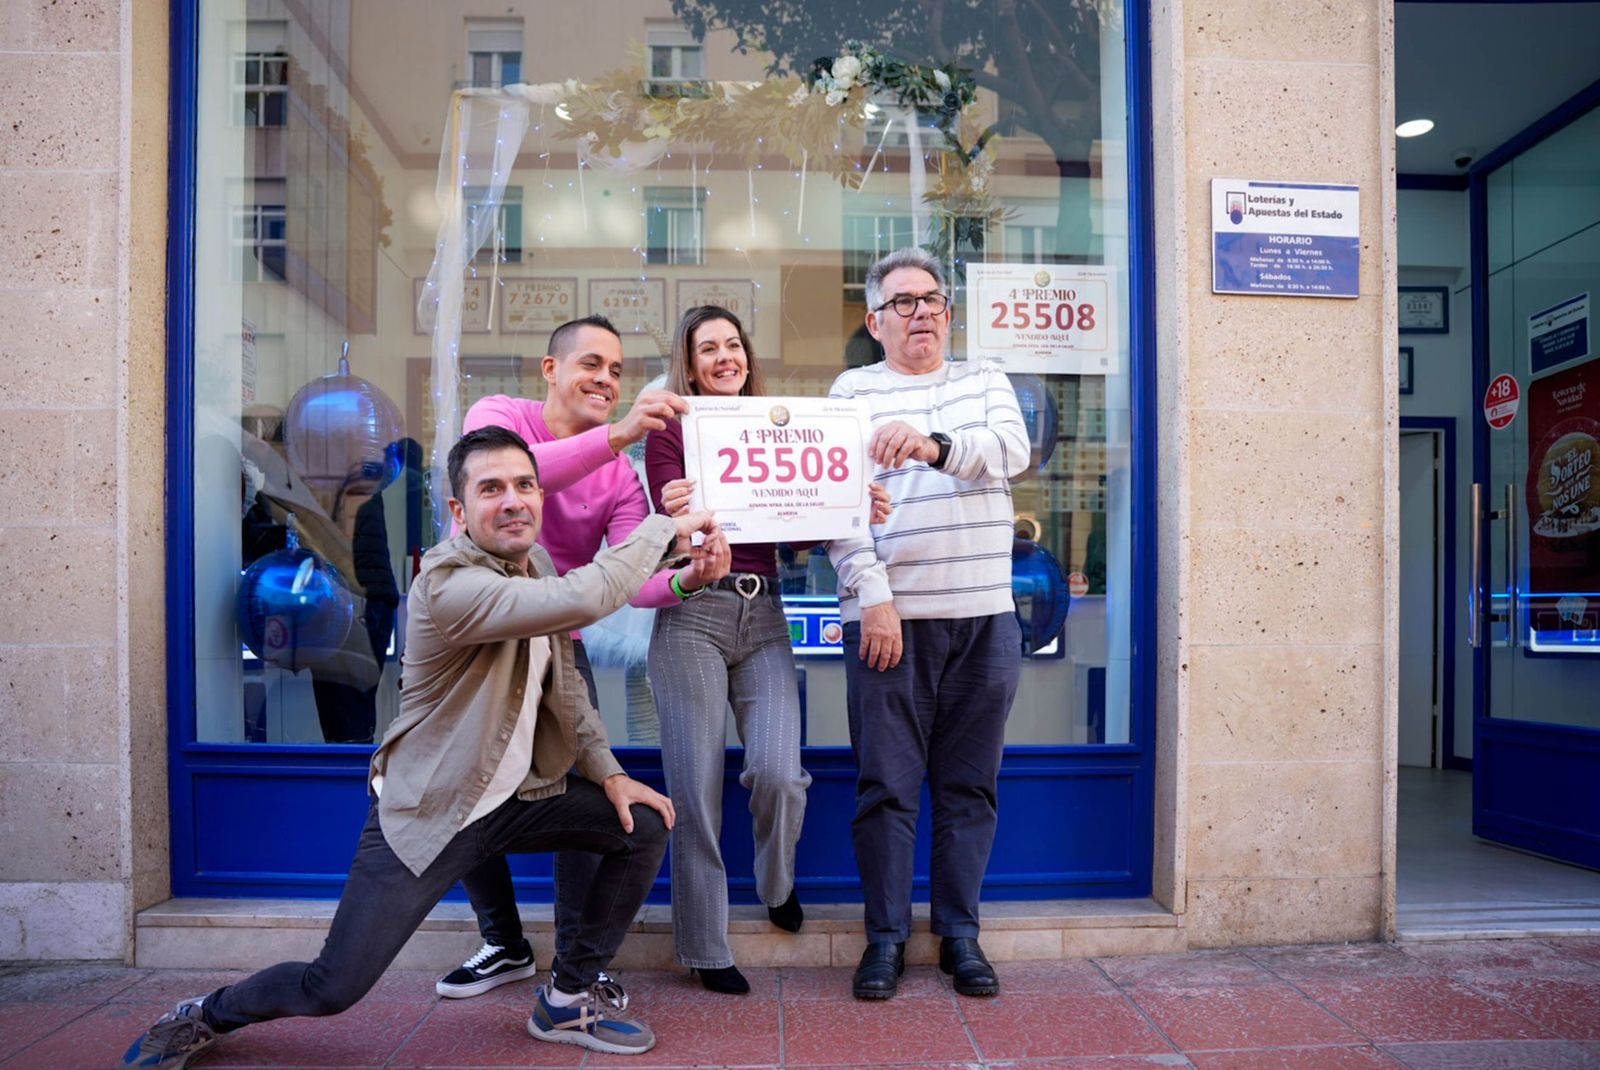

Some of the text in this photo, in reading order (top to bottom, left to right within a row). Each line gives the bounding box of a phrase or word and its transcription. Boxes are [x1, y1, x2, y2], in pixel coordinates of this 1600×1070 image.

[1248, 194, 1294, 206] Loterías y
[1248, 208, 1343, 219] Apuestas del Estado
[1269, 236, 1312, 245] HORARIO
[1295, 248, 1322, 256] Viernes
[510, 293, 568, 304] 72670
[1022, 289, 1076, 301] PREMIO
[991, 302, 1096, 331] 25508
[1491, 379, 1511, 398] +18
[756, 428, 824, 444] PREMIO
[1567, 448, 1578, 462] EL
[717, 447, 850, 484] 25508
[752, 488, 794, 498] VENDIDO
[1552, 474, 1591, 510] NOS UNE
